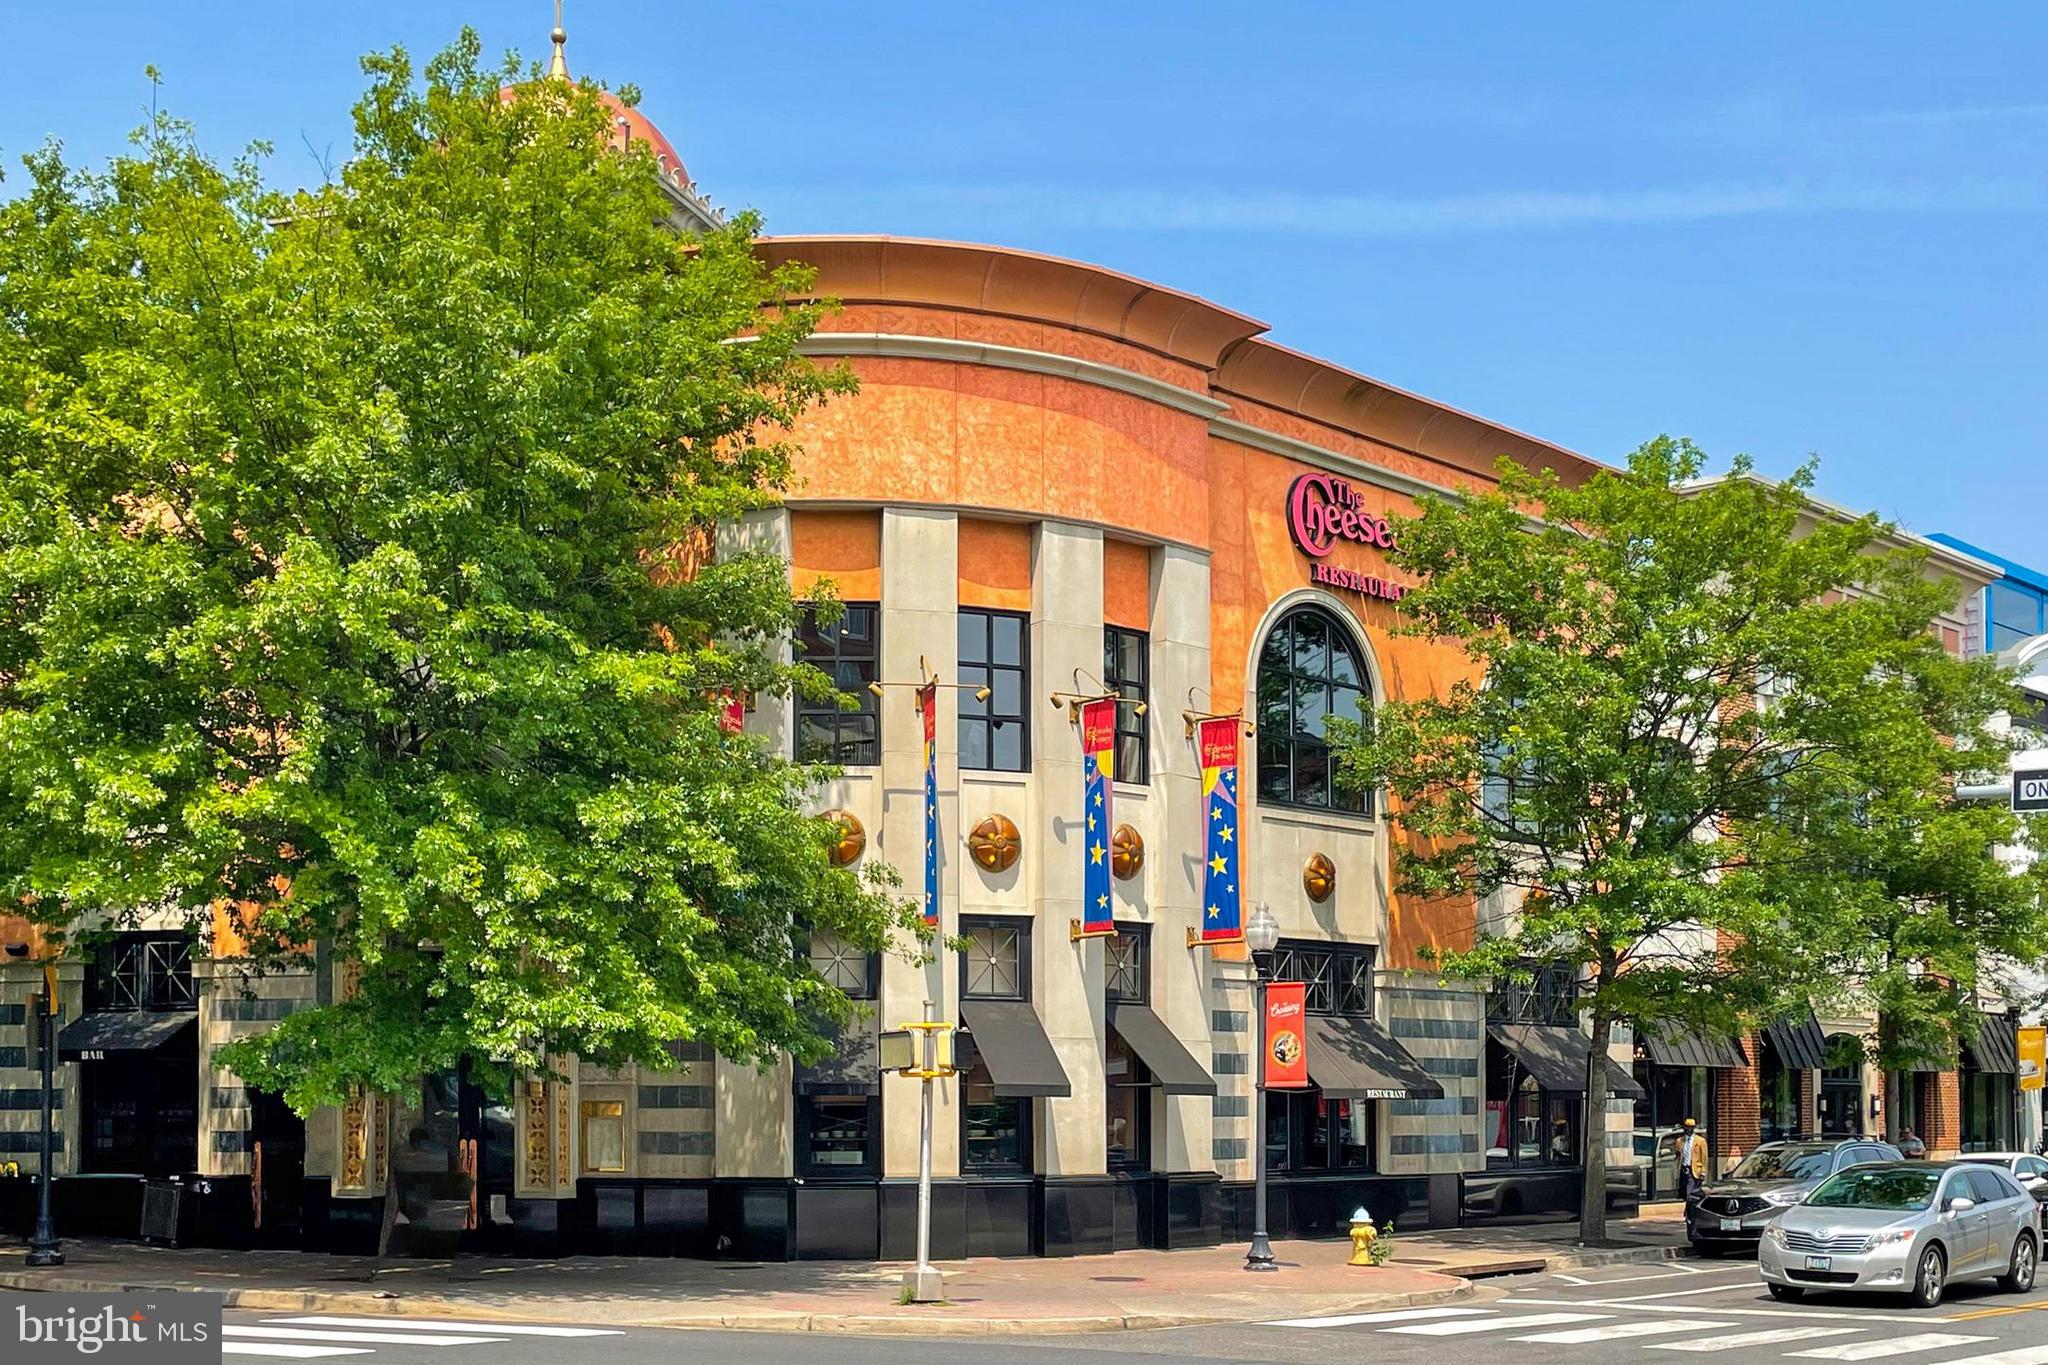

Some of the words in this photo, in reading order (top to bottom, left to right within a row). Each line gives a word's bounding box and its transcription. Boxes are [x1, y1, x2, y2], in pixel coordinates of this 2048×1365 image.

[1333, 480, 1365, 510] The
[2026, 782, 2048, 798] ON
[81, 1050, 104, 1060] BAR
[1366, 1089, 1407, 1099] RESTAURANT
